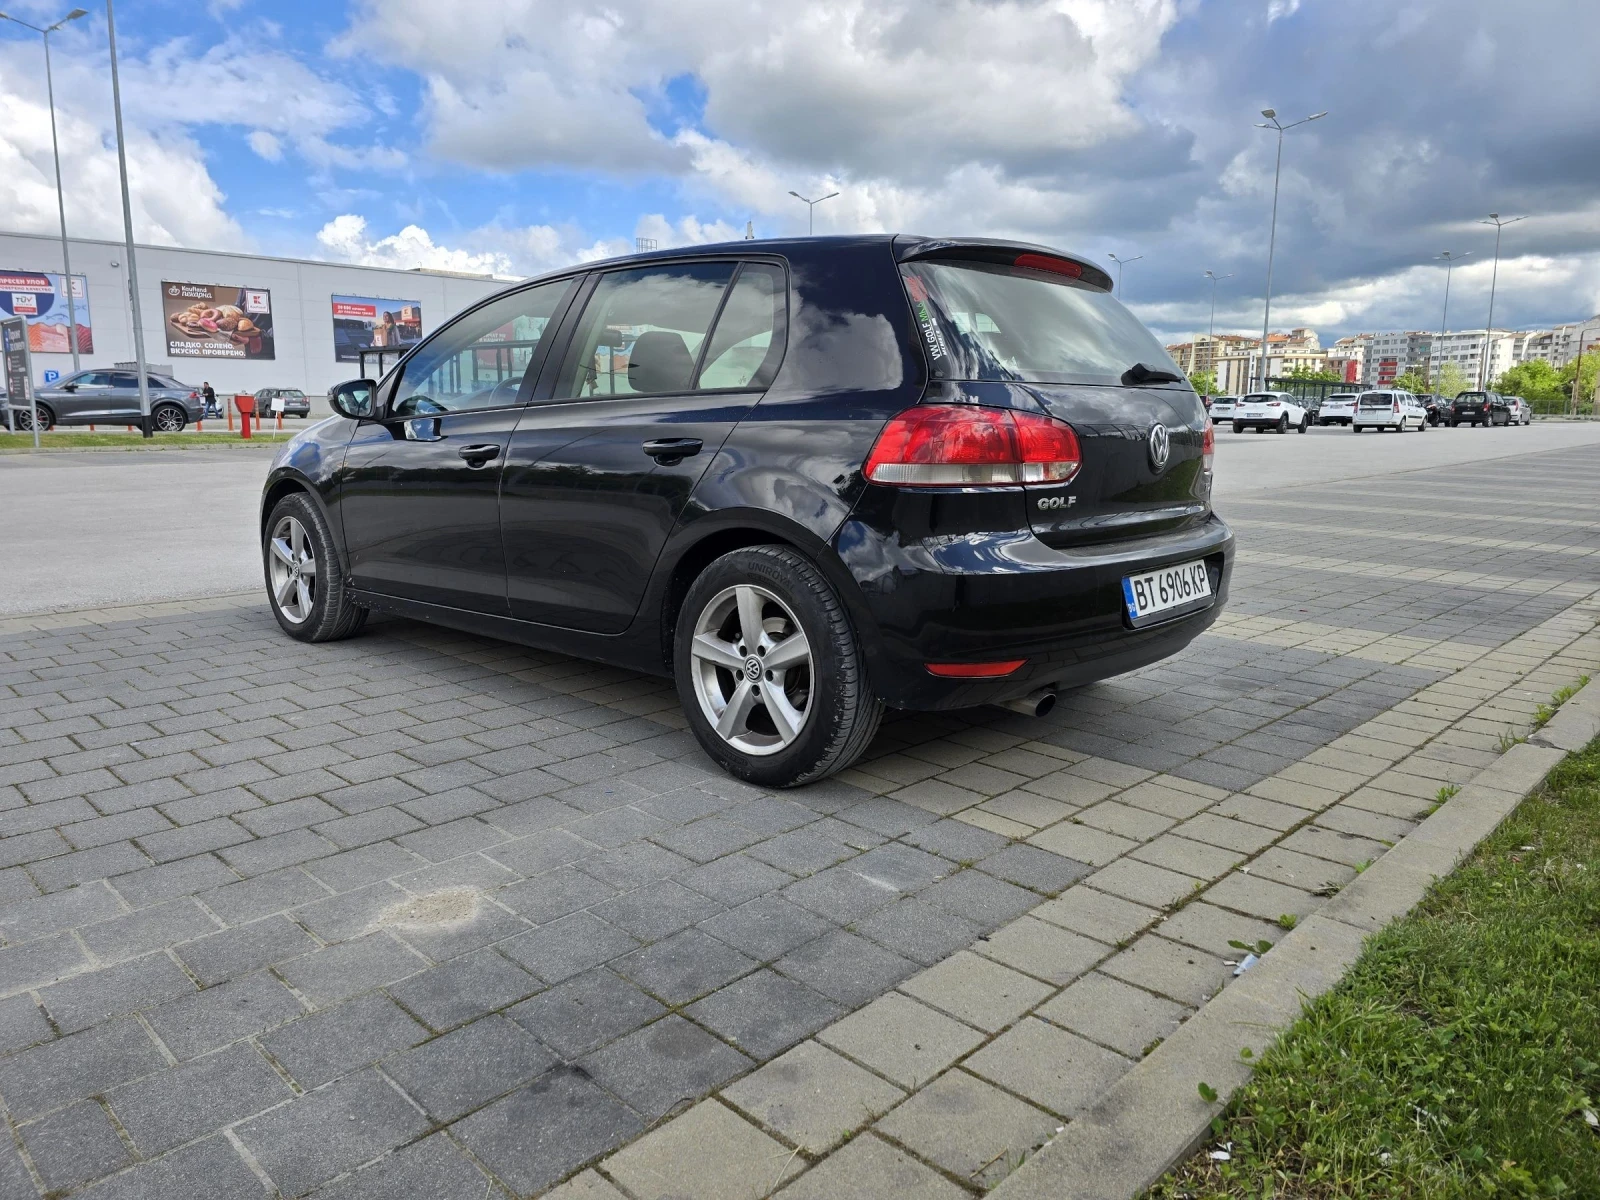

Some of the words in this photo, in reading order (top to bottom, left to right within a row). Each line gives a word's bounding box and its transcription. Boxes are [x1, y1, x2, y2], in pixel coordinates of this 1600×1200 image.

[181, 285, 208, 294] Kaufland
[15, 295, 33, 303] TÜV
[921, 322, 937, 343] GOLF
[170, 341, 203, 349] СЛАДКО.
[204, 342, 235, 350] СОЛЕНО.
[202, 349, 246, 357] ПРОВЕРЕНО.
[929, 344, 941, 361] VW
[1037, 495, 1077, 511] GOLF
[748, 562, 796, 595] UNIROYAL
